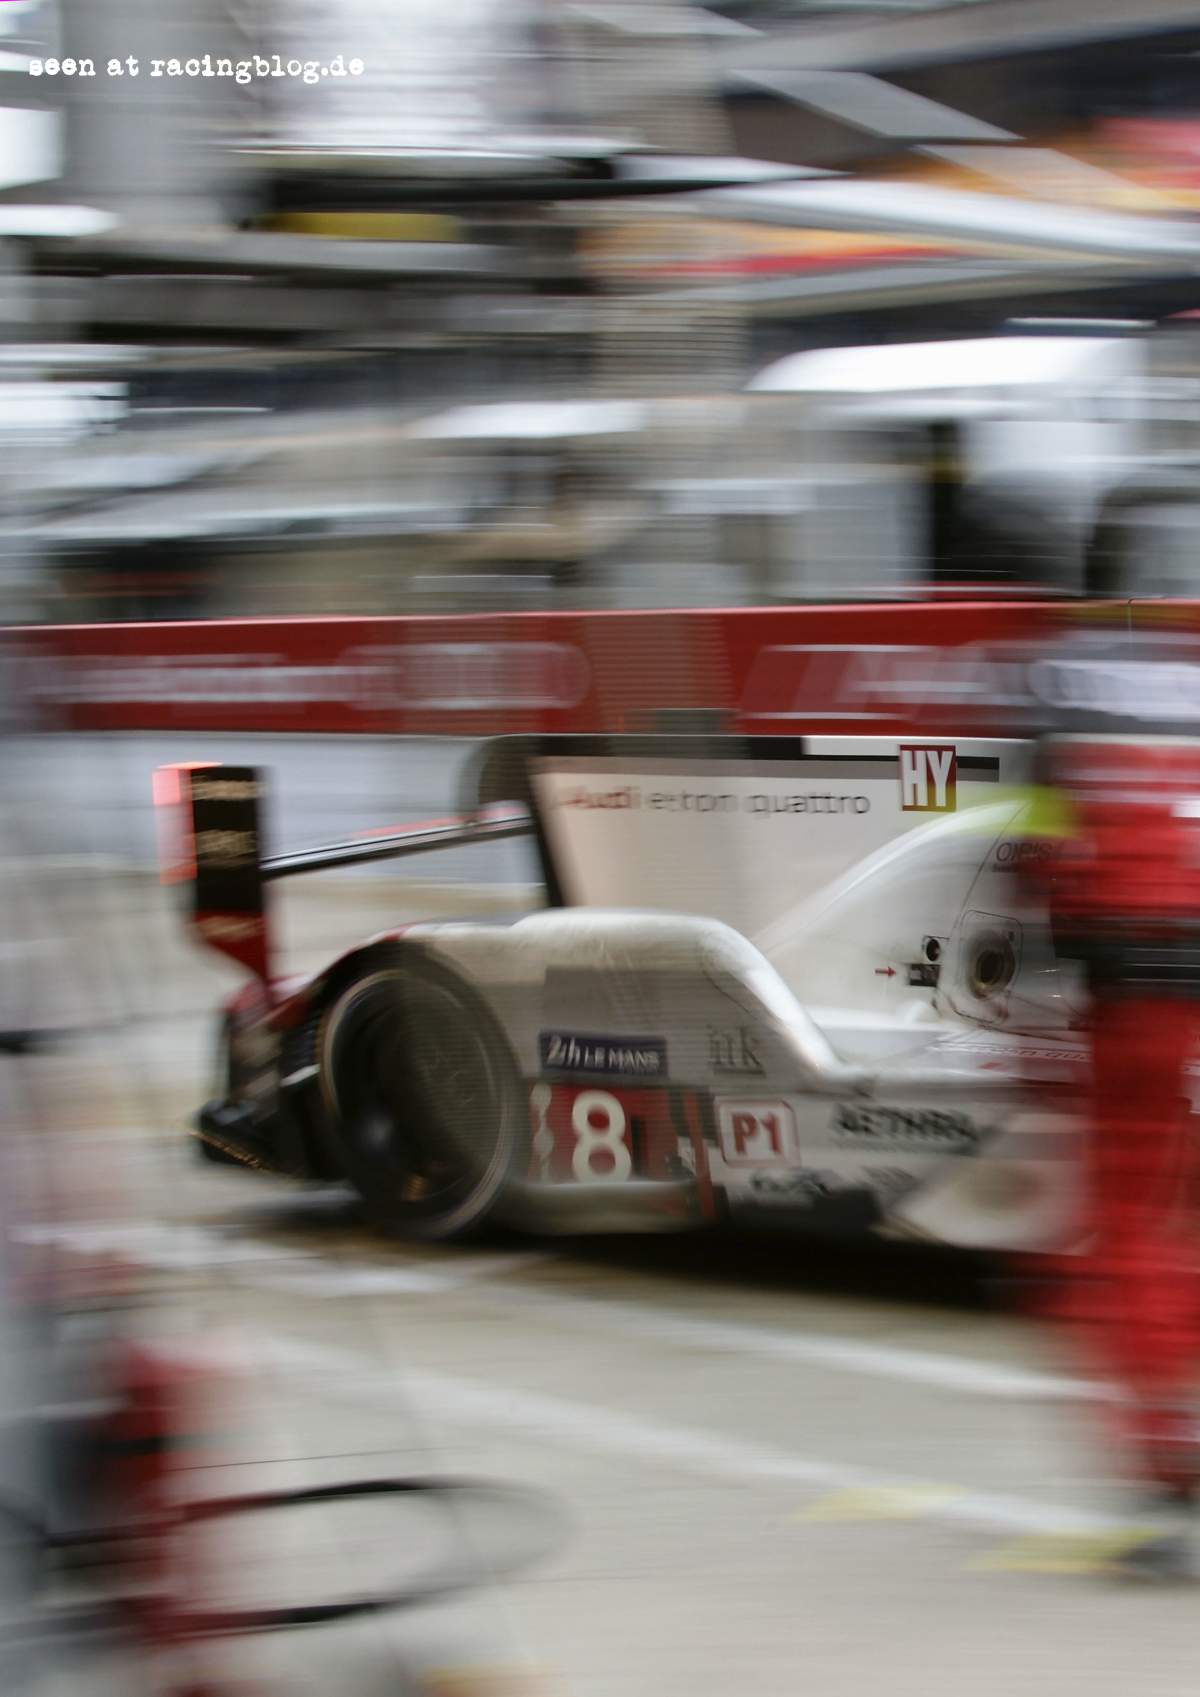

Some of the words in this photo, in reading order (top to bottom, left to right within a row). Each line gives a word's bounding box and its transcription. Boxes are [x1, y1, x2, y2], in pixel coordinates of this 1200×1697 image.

[902, 750, 953, 806] HY
[750, 793, 872, 819] quattro
[572, 1089, 632, 1183] 8
[732, 1111, 782, 1155] P1
